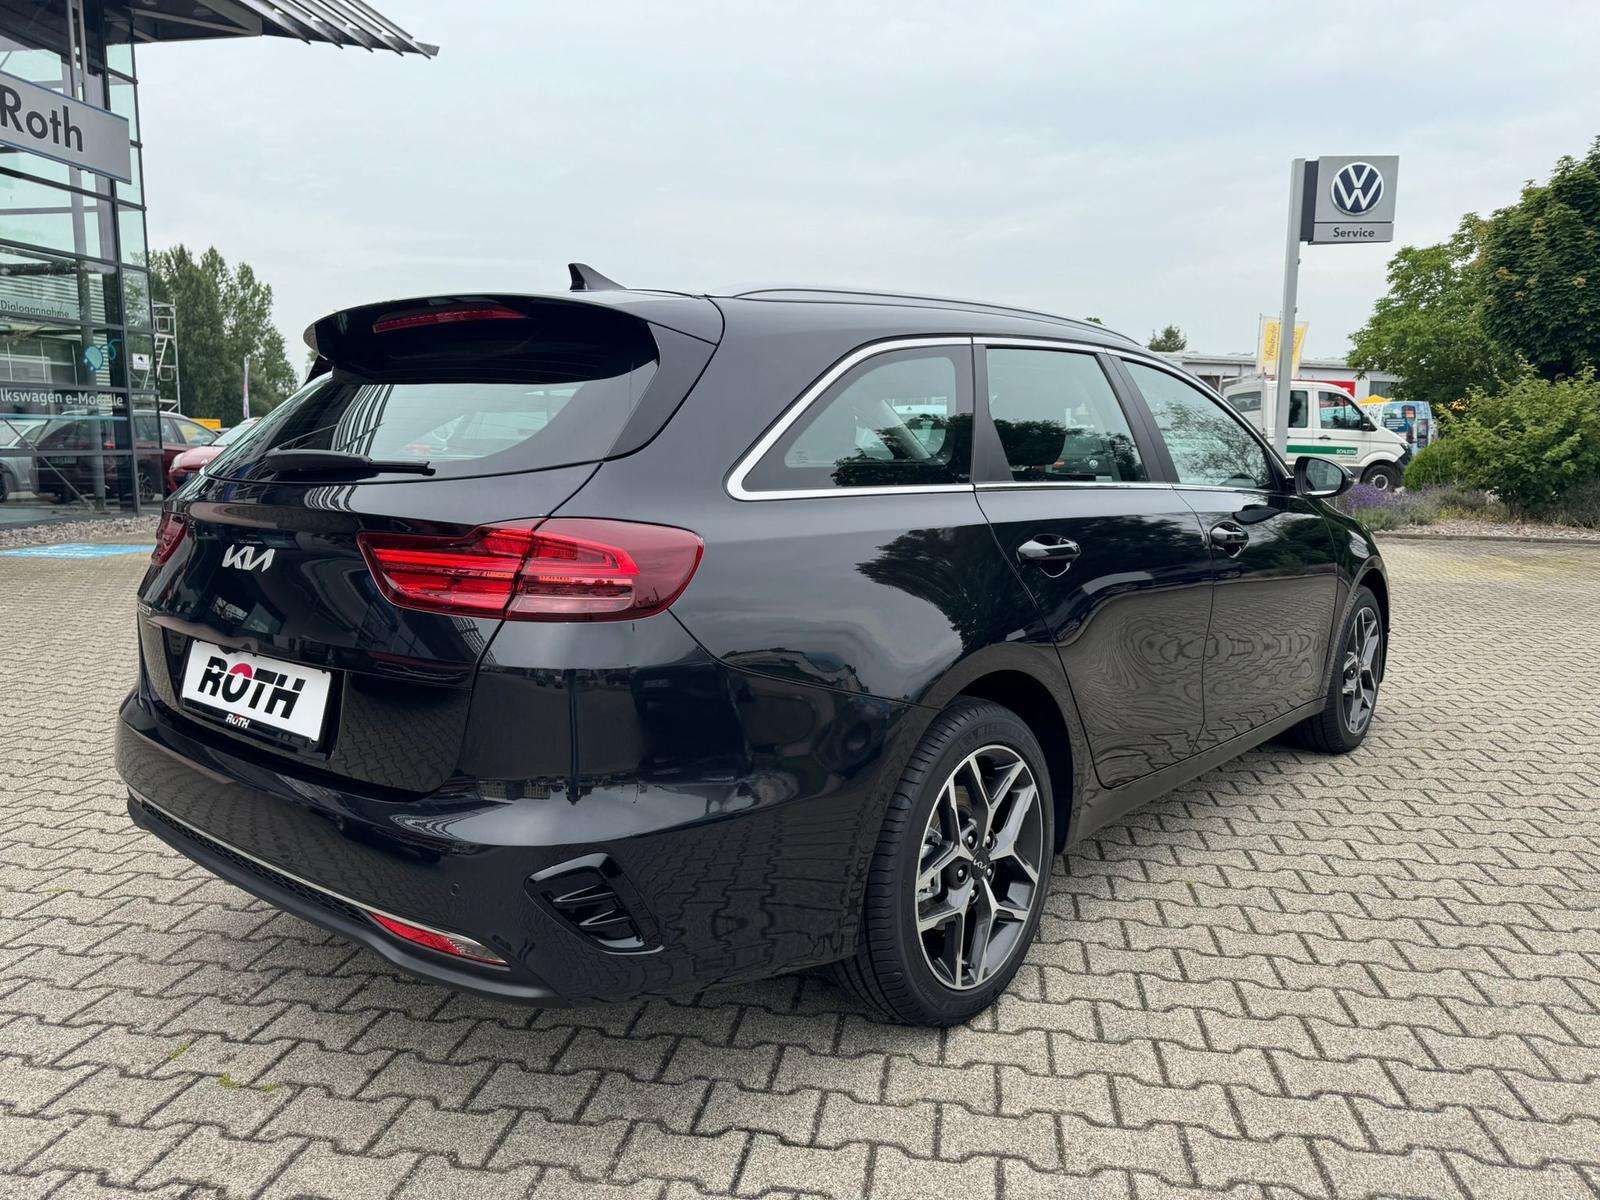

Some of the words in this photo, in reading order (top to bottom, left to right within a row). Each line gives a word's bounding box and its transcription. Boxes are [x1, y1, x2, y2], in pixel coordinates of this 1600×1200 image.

[0, 84, 83, 153] Roth
[1333, 227, 1375, 238] Service
[198, 656, 306, 719] ROTH
[225, 713, 250, 729] ROTH
